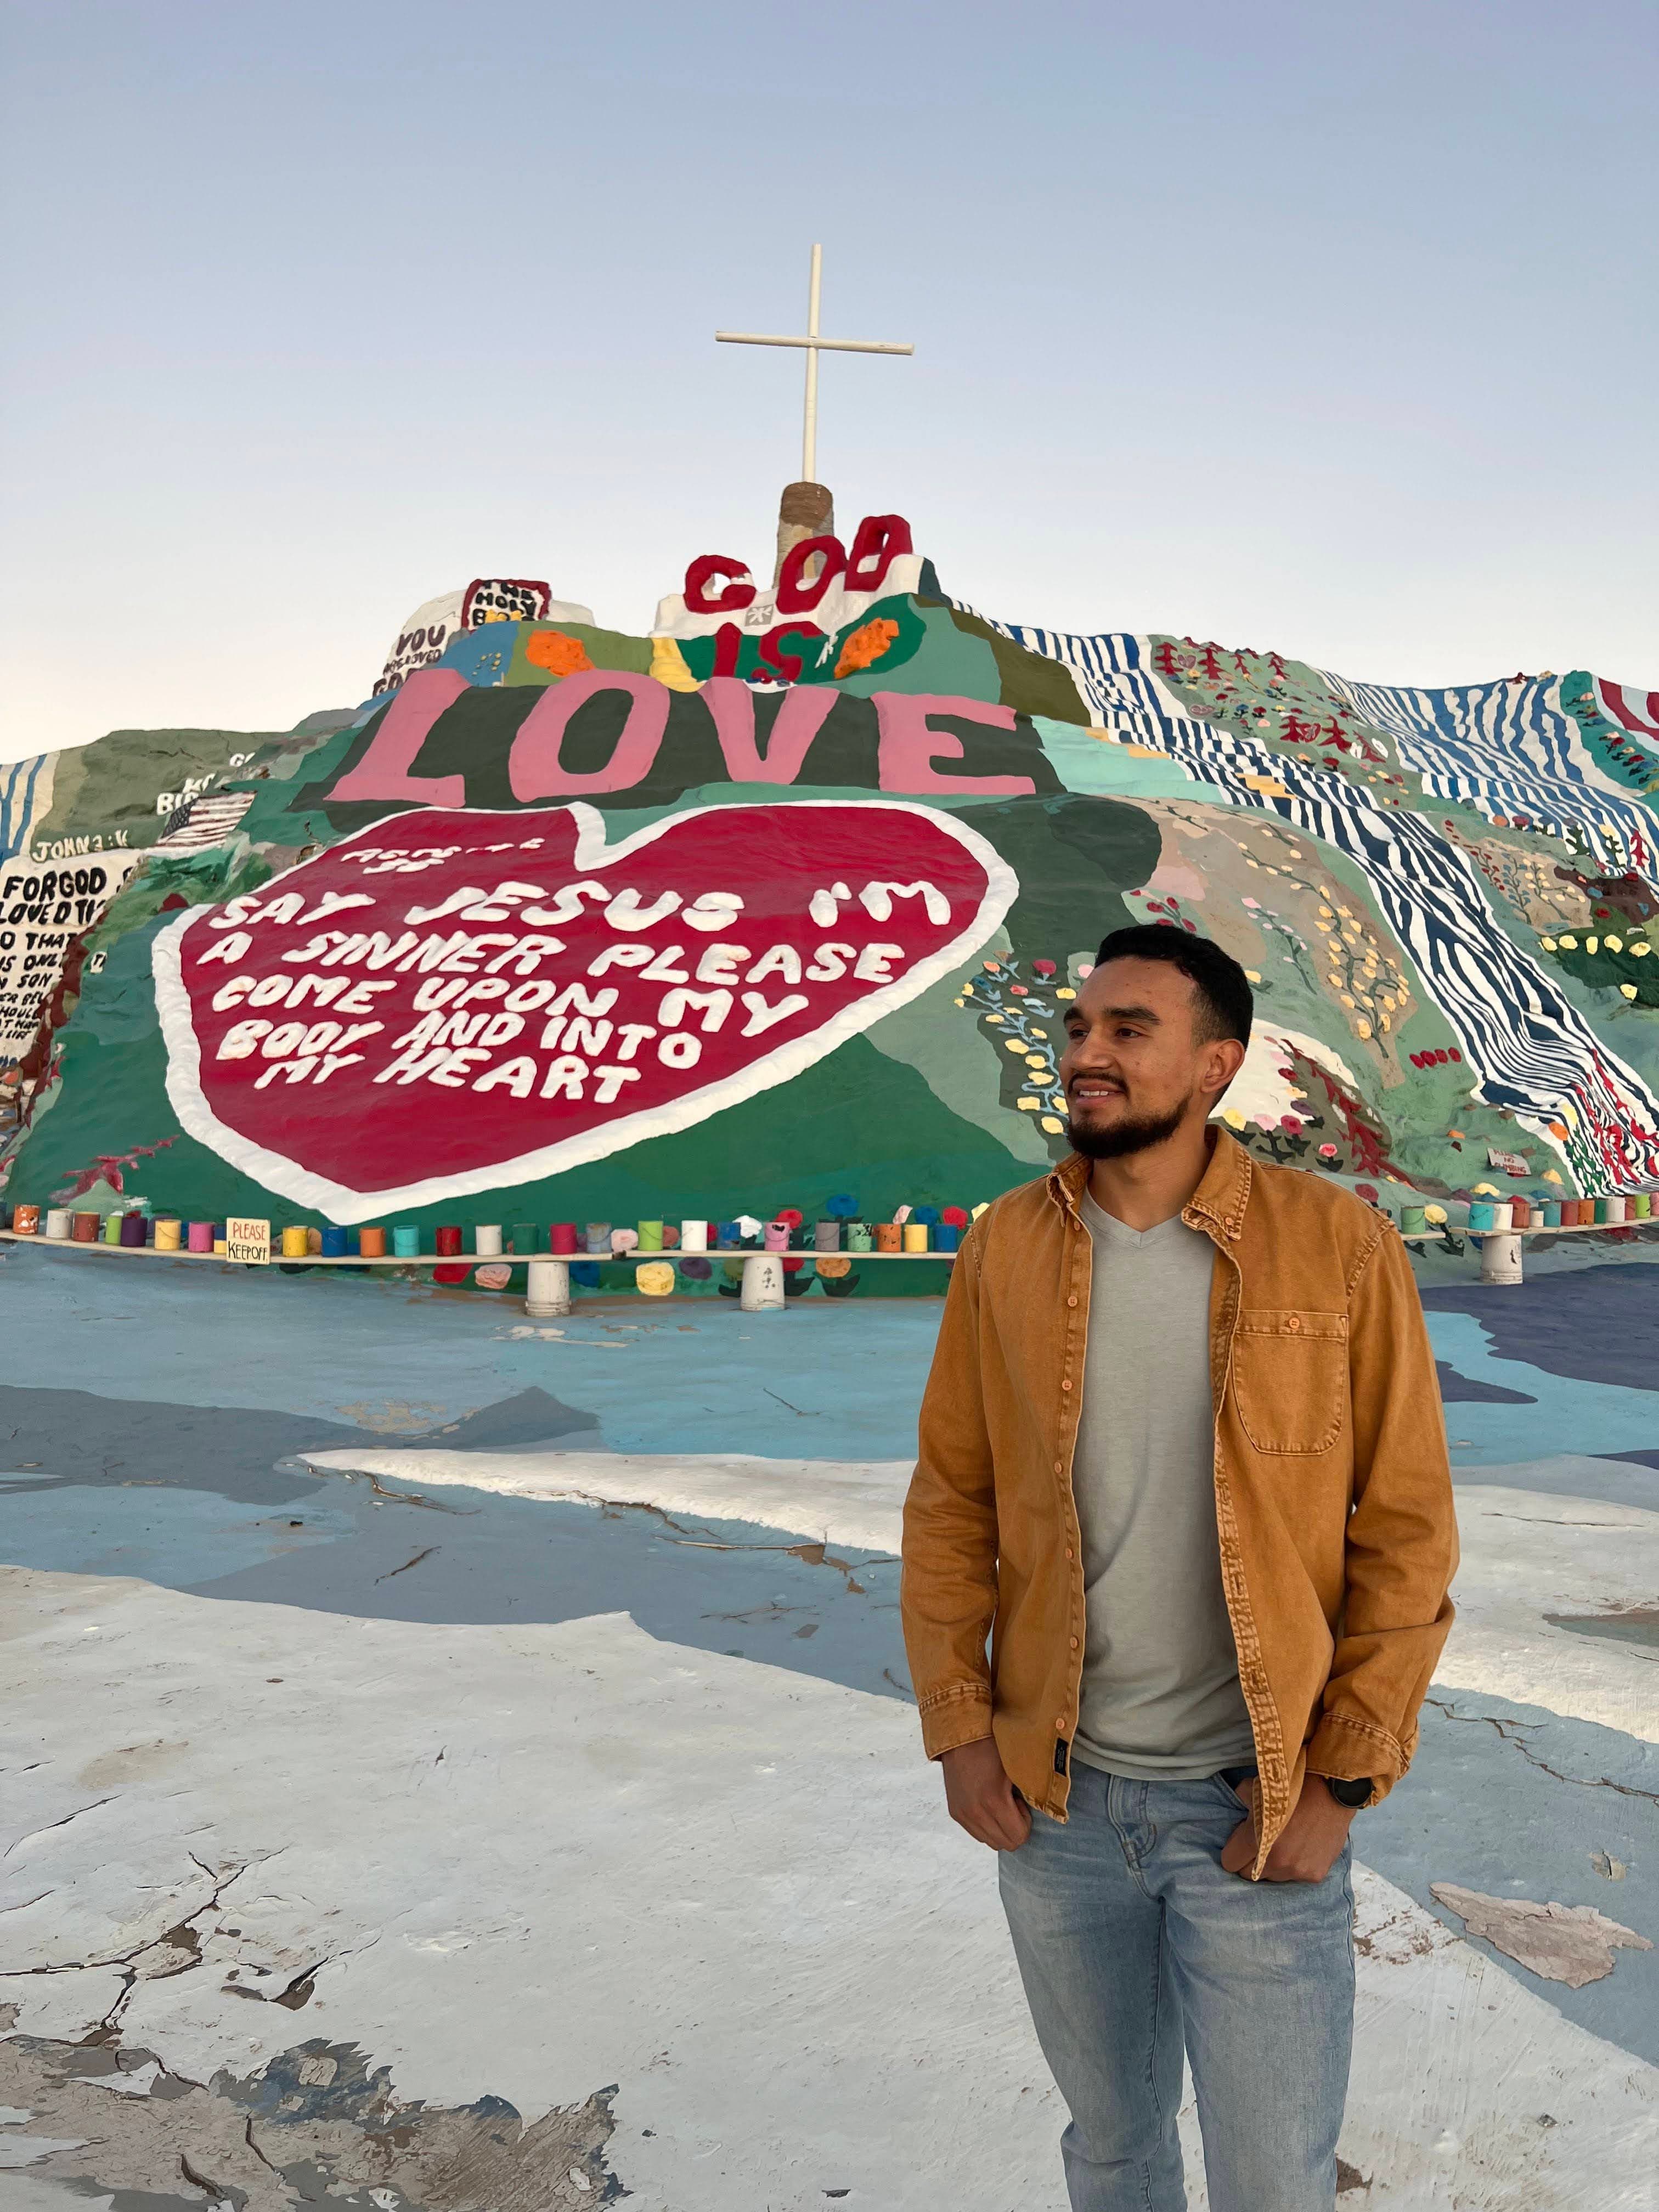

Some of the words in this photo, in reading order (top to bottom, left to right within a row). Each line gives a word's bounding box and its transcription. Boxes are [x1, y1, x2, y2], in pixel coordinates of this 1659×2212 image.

[684, 514, 913, 615] GOD
[396, 624, 446, 656] YOU
[715, 621, 825, 684] IS
[323, 668, 1036, 809] LOVE
[32, 834, 90, 863] JOHN
[58, 866, 107, 899] GOD
[208, 892, 376, 929] SAY
[404, 880, 745, 932] JESUS
[809, 880, 951, 928] I'M
[196, 931, 253, 966] A
[281, 930, 567, 975] SINNER
[587, 943, 905, 986] PLEASE
[212, 974, 397, 1014] COME
[413, 977, 619, 1017] UPON
[657, 988, 809, 1037] MY
[215, 1019, 385, 1060] BODY
[392, 1009, 526, 1050] AND
[540, 1015, 702, 1070] INTO
[253, 1052, 366, 1090] MY
[373, 1047, 642, 1104] HEART
[233, 1221, 266, 1241] PLEASE
